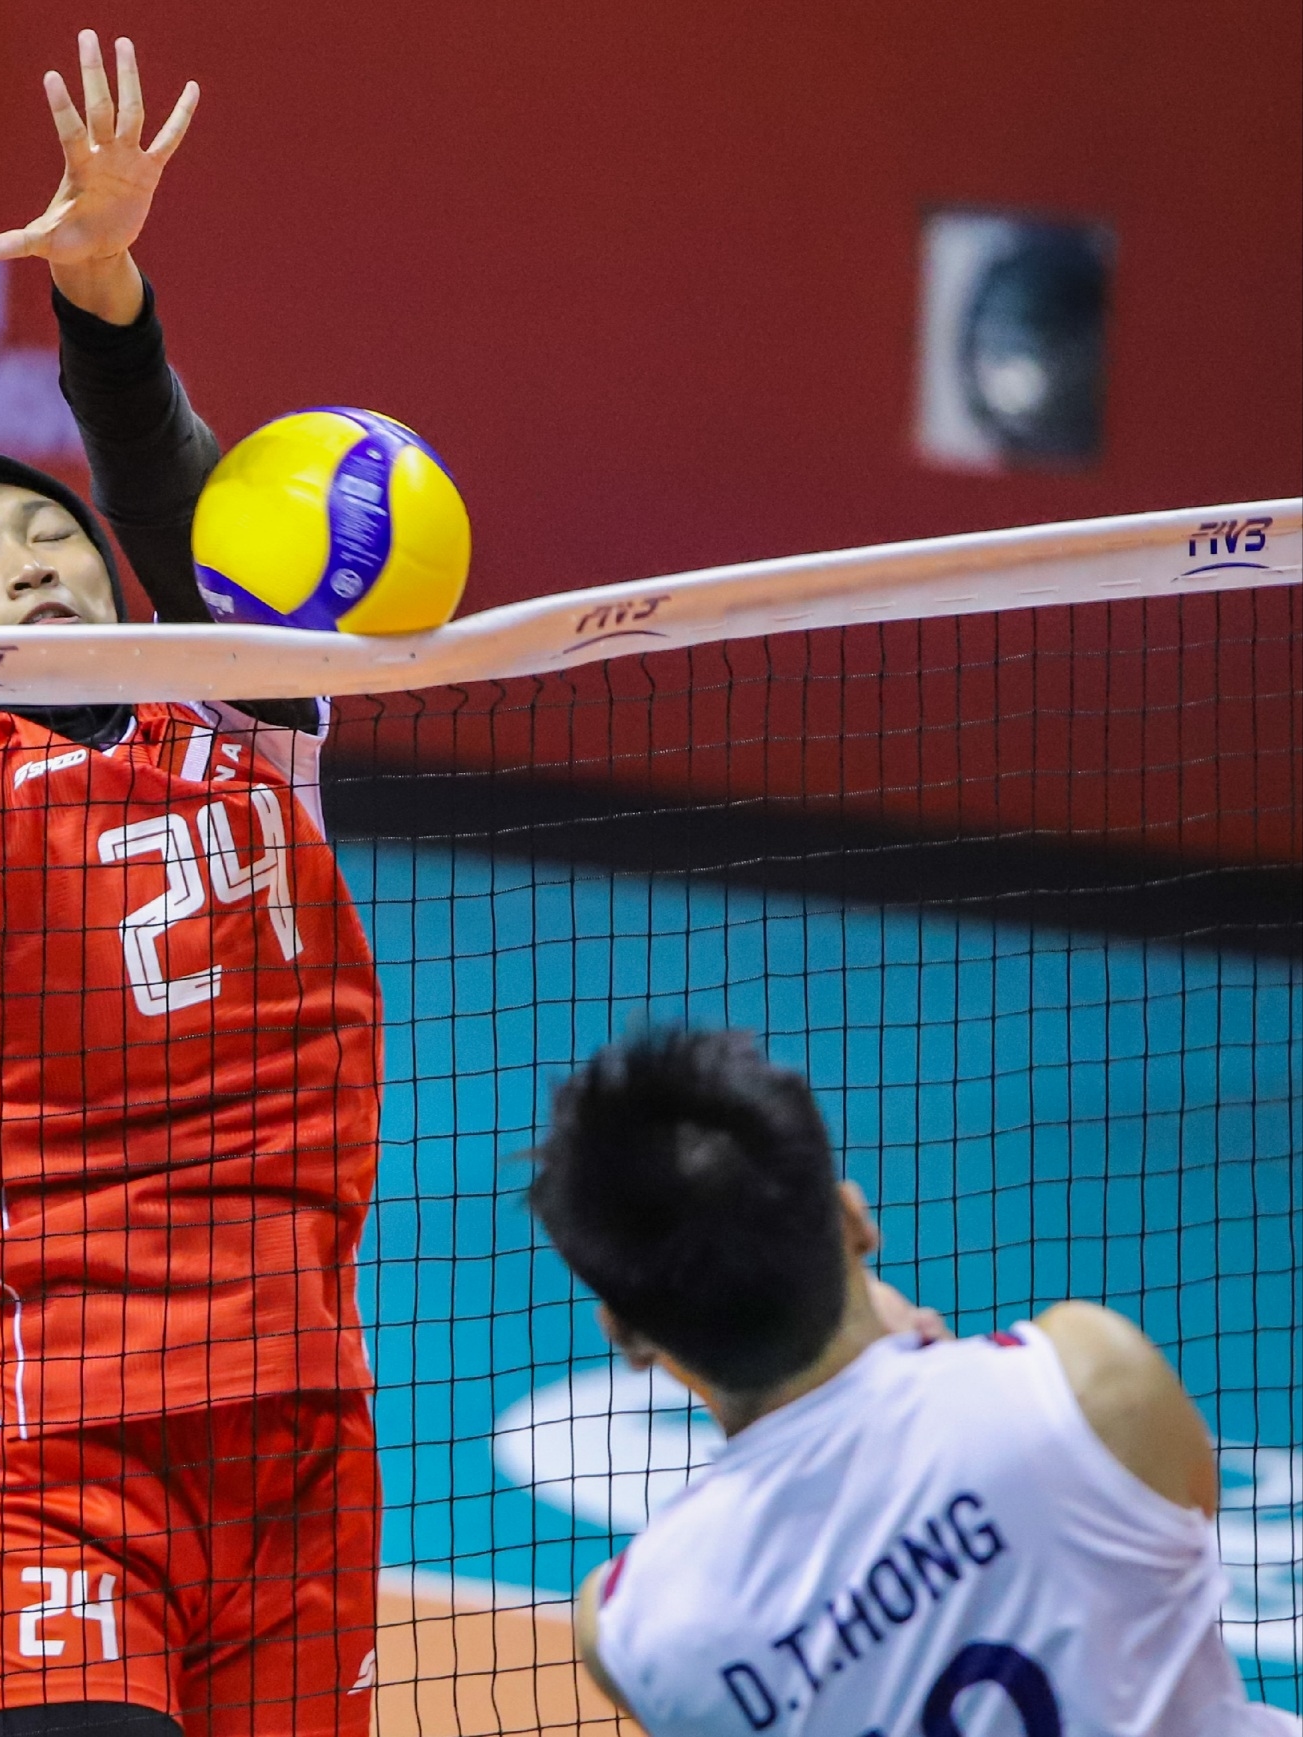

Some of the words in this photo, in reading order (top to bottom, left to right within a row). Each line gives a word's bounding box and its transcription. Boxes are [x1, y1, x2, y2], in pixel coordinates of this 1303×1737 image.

[1189, 517, 1273, 556] FIVB
[97, 784, 304, 1016] 24
[19, 1567, 118, 1660] 24
[719, 1490, 1007, 1731] D.T.HONG
